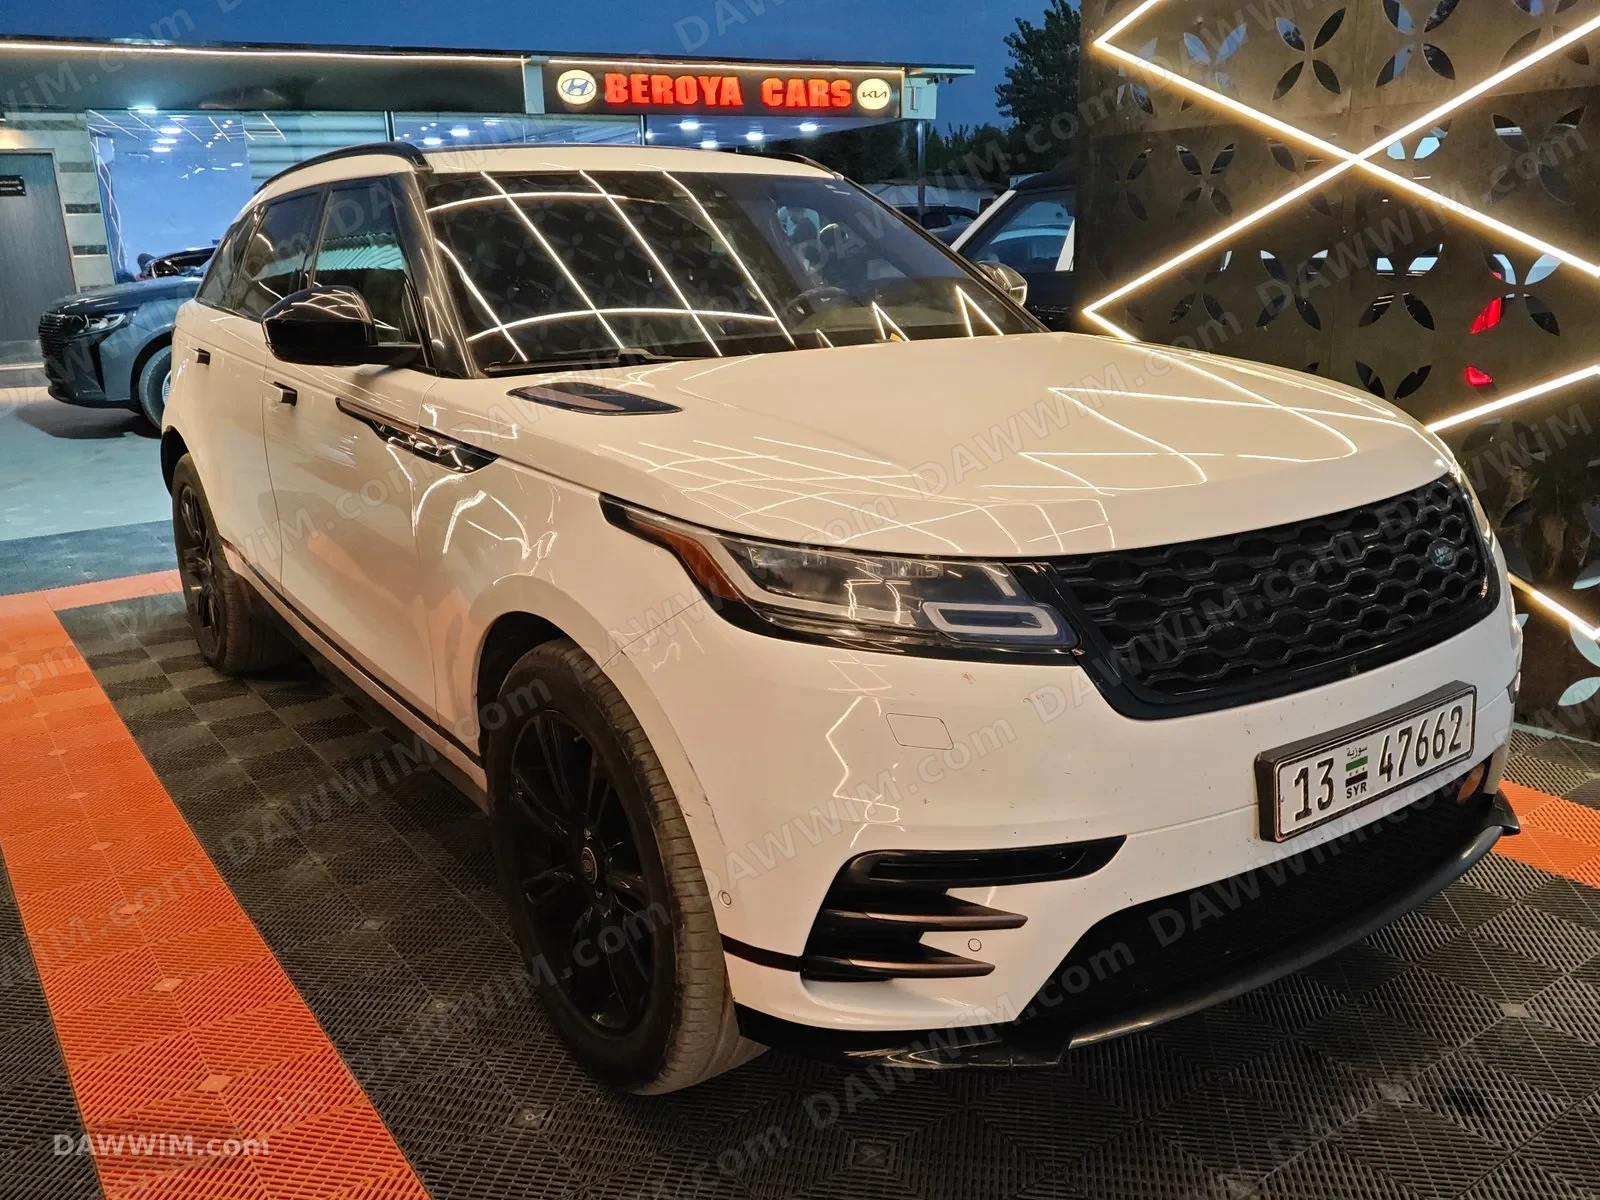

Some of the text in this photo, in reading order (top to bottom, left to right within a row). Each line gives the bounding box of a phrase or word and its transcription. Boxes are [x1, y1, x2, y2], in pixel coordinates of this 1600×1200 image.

[605, 73, 852, 107] BEROYA CARS
[1294, 705, 1463, 821] 13 47662
[1346, 782, 1367, 799] SYR
